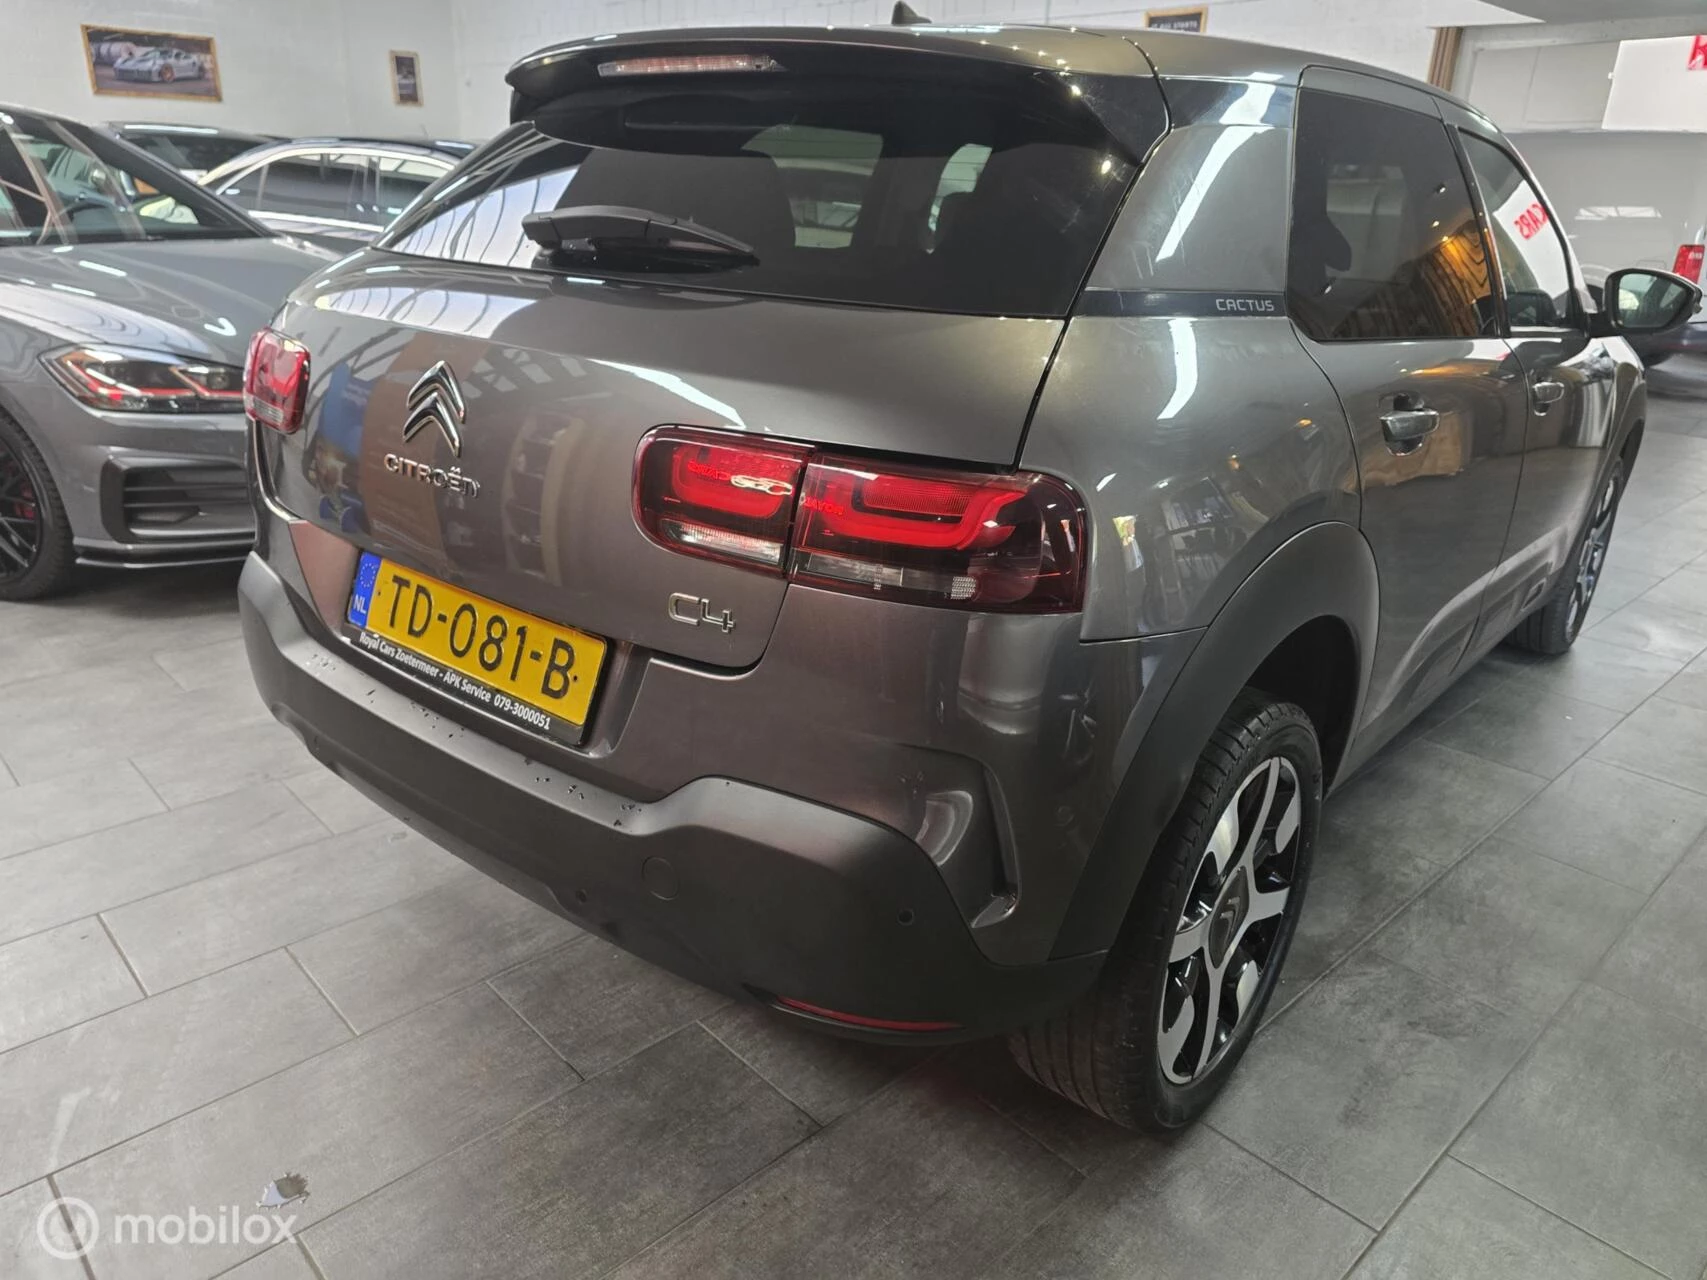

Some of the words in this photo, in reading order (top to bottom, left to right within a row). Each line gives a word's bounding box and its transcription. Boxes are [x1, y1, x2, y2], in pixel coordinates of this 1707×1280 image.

[1215, 298, 1275, 312] CACTUS
[384, 453, 480, 498] CITROËN
[353, 594, 367, 614] NL
[668, 592, 735, 633] C4
[389, 575, 577, 699] TD-081-B
[359, 631, 380, 651] Royal
[380, 641, 395, 657] Cars
[395, 646, 440, 677] Zoetermeer
[443, 671, 463, 689] APK
[461, 681, 491, 703] Service
[493, 694, 551, 730] 079-3000051
